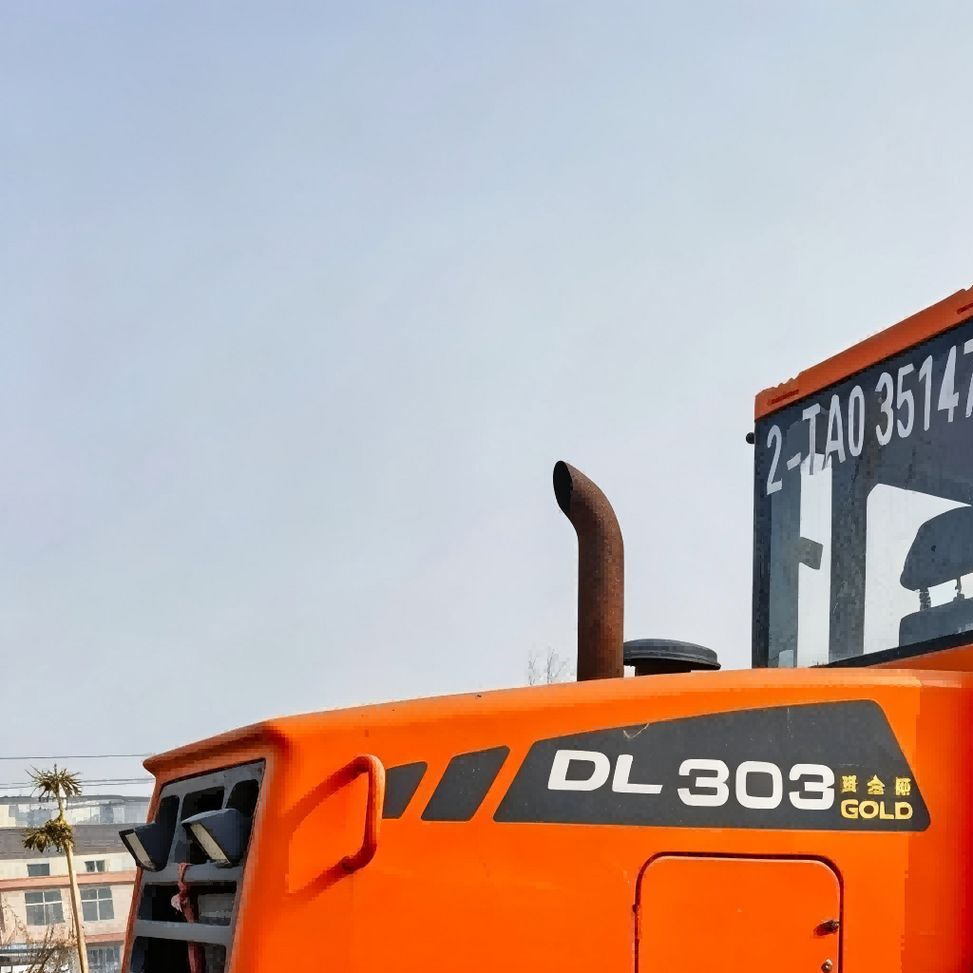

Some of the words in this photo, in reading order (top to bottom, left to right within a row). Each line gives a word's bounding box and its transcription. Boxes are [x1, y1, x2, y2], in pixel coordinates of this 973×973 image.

[547, 749, 663, 794] DL
[676, 758, 835, 811] 303
[840, 799, 914, 820] GOLD
